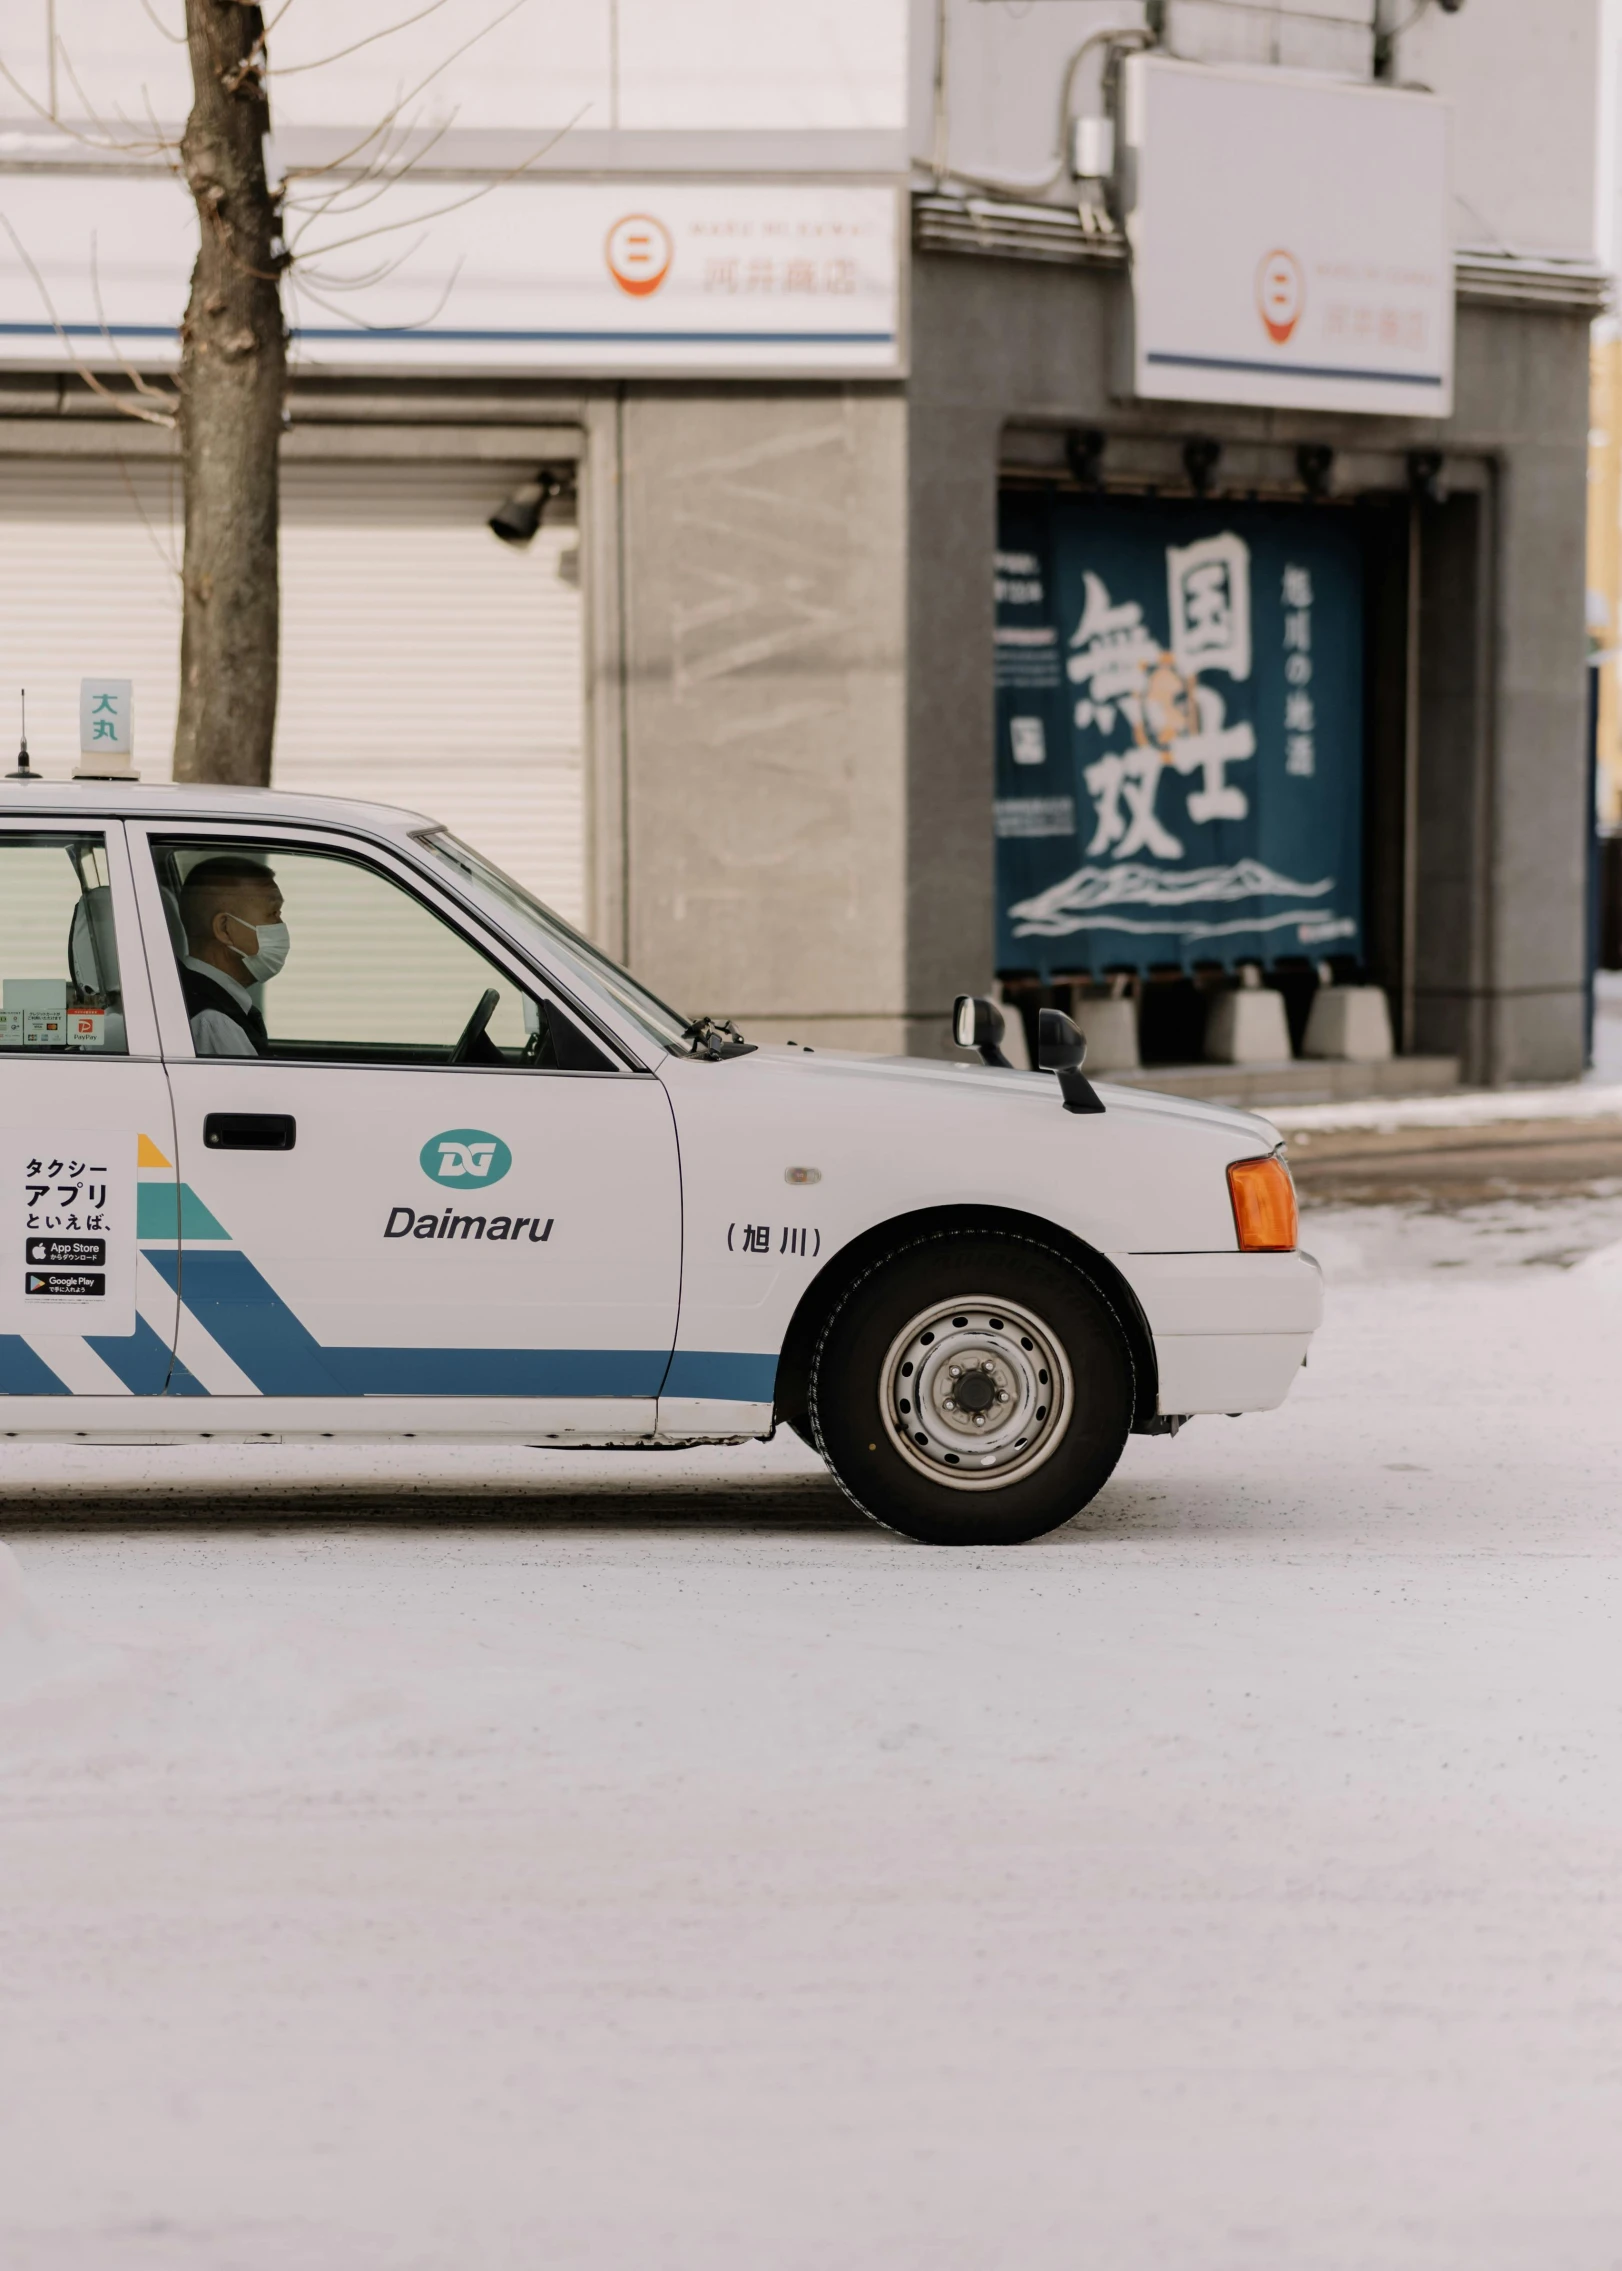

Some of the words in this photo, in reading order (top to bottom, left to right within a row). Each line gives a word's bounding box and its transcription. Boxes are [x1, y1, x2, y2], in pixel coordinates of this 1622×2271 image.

[1166, 530, 1256, 824] 国士
[92, 693, 118, 741] 大丸
[1066, 570, 1185, 859] 無双
[26, 1158, 107, 1178] タクシー
[25, 1181, 106, 1209] アプリ
[26, 1213, 111, 1231] といえば、
[383, 1206, 554, 1242] Daimaru
[51, 1243, 71, 1253] App
[73, 1243, 99, 1252] Store
[49, 1276, 77, 1286] Google
[78, 1277, 94, 1286] Play
